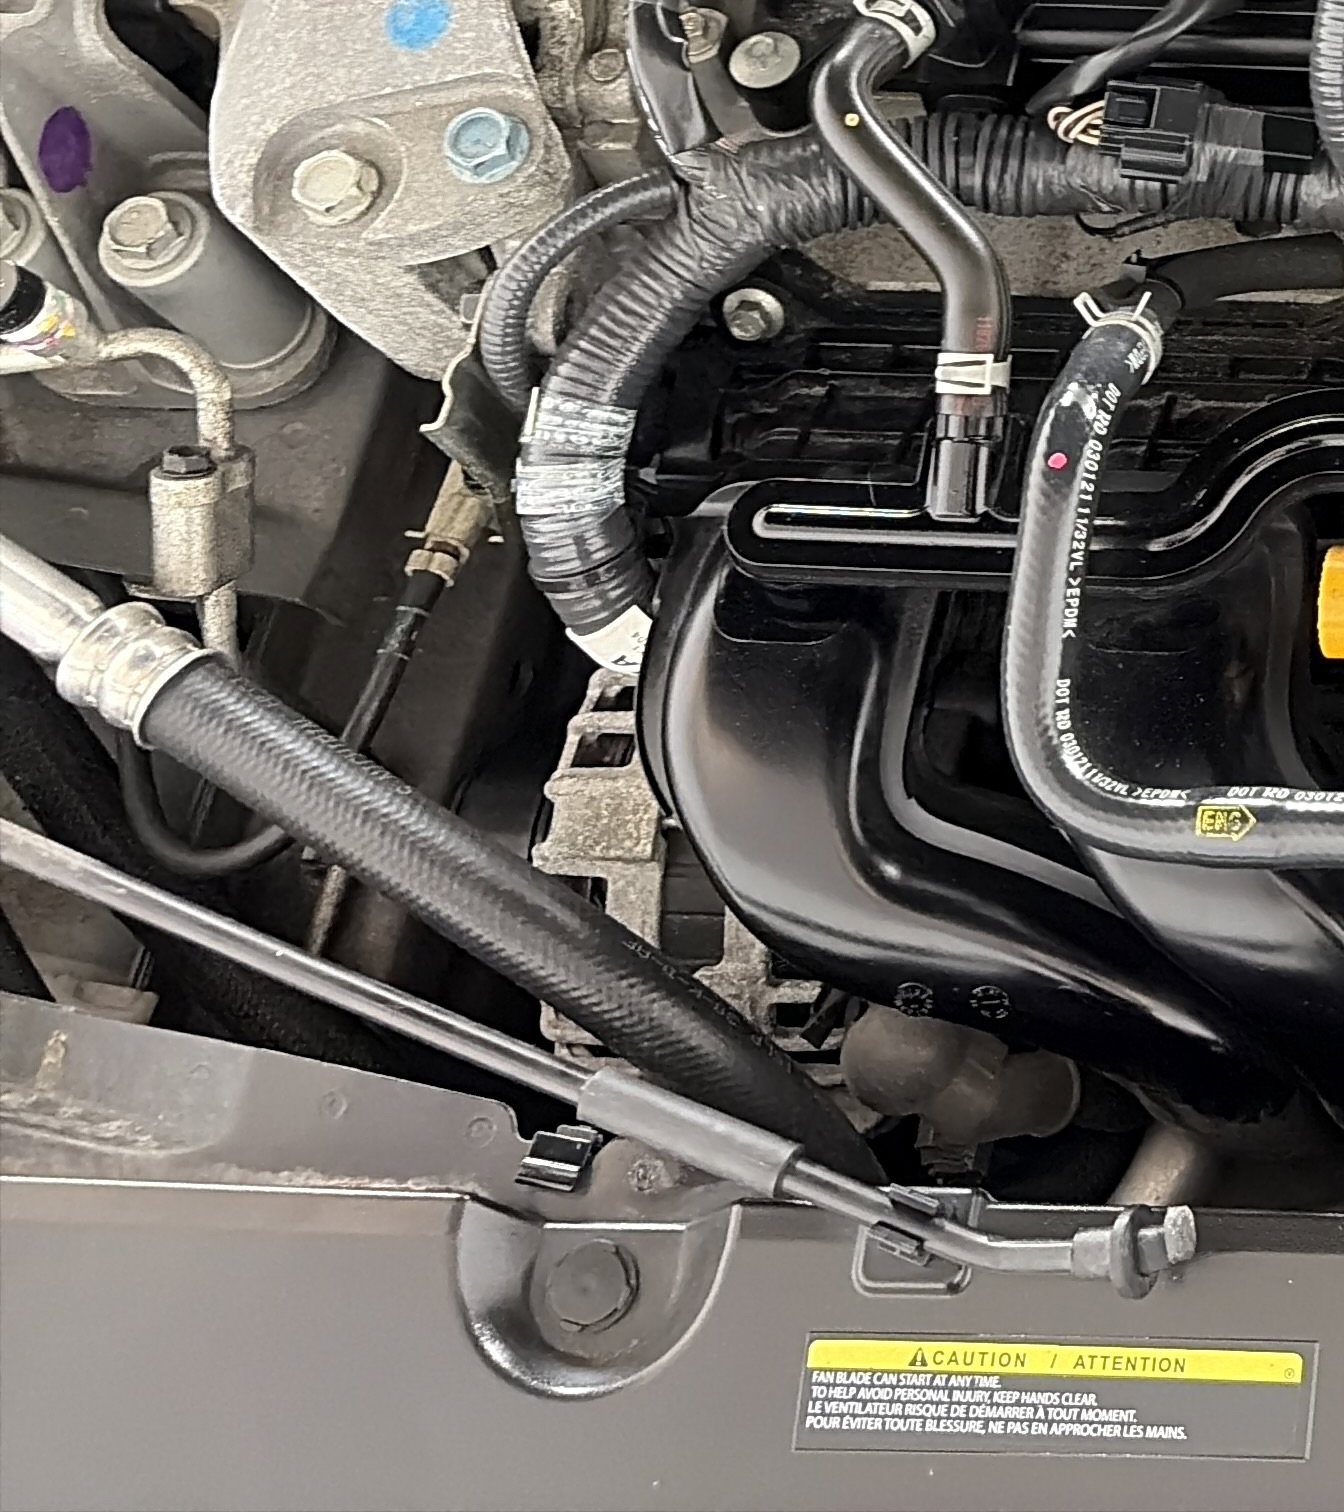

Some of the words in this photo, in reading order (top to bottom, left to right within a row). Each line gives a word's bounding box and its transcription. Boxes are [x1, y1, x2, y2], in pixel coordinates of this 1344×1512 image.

[1101, 380, 1122, 411] DOT
[1076, 437, 1101, 501] 030121
[1067, 505, 1093, 572] 11/32VL
[1059, 574, 1083, 639] >EPDM<
[1049, 676, 1076, 707] DOT
[1225, 783, 1257, 800] DOT
[932, 1348, 1025, 1368] CAUTION
[1072, 1353, 1185, 1373] ATTENTION
[812, 1369, 835, 1383] FAN
[836, 1370, 872, 1384] BLADE
[873, 1371, 897, 1385] CAN
[898, 1372, 932, 1386] START
[932, 1373, 946, 1386] AT
[947, 1374, 975, 1387] ANY
[811, 1384, 827, 1398] TO
[828, 1385, 856, 1399] HELP
[856, 1386, 892, 1400] AVOID
[893, 1387, 950, 1402] PERSONAL
[951, 1389, 991, 1405] INJURY,
[993, 1390, 1019, 1404] KEEP
[1021, 1391, 1060, 1406] HANDS
[807, 1399, 823, 1413] LE
[824, 1400, 903, 1415] VENTILATEUR
[904, 1403, 949, 1417] RISQUE
[950, 1404, 967, 1417] DE
[968, 1403, 1034, 1420] DÉMARRER
[1034, 1405, 1045, 1420] À
[1046, 1407, 1079, 1421] TOUT
[1080, 1409, 1137, 1423] MOMENT.
[805, 1414, 841, 1428] POUR
[842, 1414, 883, 1430] ÉVITER
[884, 1417, 924, 1431] TOUTE
[925, 1418, 984, 1434] BLESSURE,
[988, 1420, 1006, 1434] NE
[1009, 1421, 1031, 1434] PAS
[1031, 1422, 1048, 1435] EN
[1049, 1422, 1122, 1437] APPROCHER
[1122, 1425, 1144, 1438] LES
[1145, 1426, 1186, 1440] MAINS.
